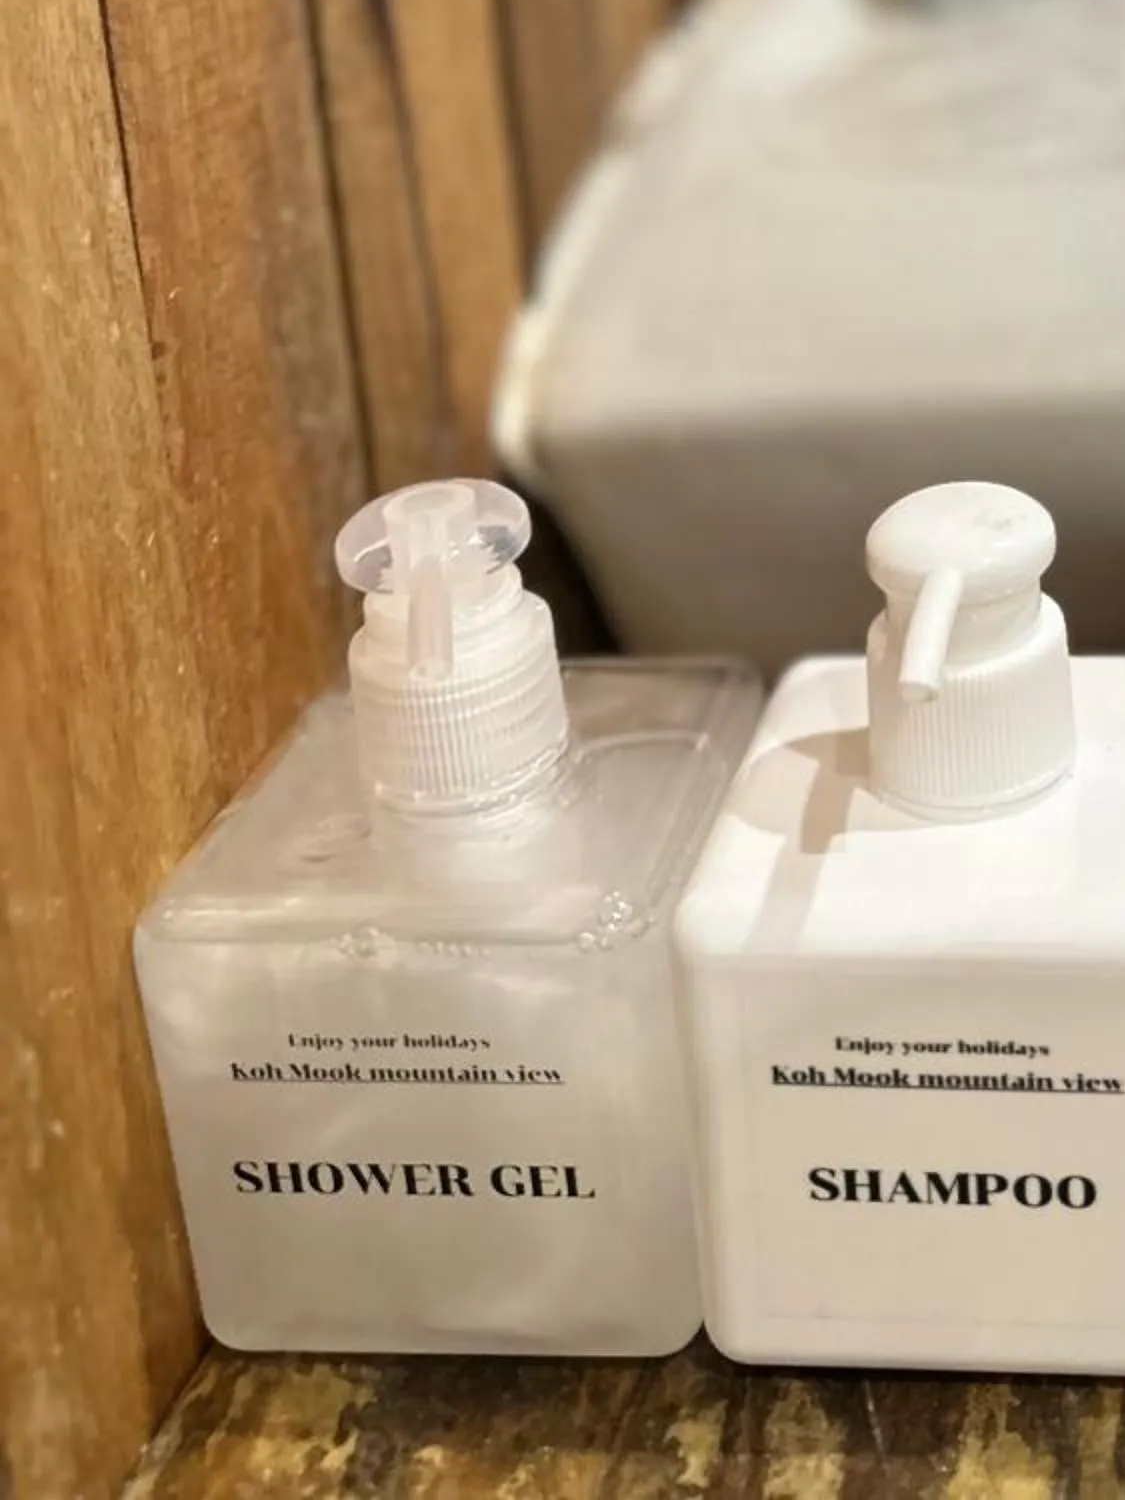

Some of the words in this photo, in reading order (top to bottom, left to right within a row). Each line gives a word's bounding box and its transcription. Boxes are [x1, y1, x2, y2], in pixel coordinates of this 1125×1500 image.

[288, 1032, 345, 1051] Enjoy
[351, 1036, 397, 1051] your
[402, 1033, 492, 1051] holidays
[834, 1036, 895, 1056] Enjoy
[901, 1041, 952, 1056] your
[957, 1038, 1051, 1057] holidays
[231, 1062, 284, 1081] Koh
[288, 1064, 362, 1082] Mook
[369, 1064, 497, 1083] mountain
[504, 1065, 562, 1084] view
[771, 1065, 826, 1085] Koh
[832, 1067, 911, 1087] Mook
[918, 1070, 1053, 1091] mountain
[1061, 1073, 1123, 1093] view
[232, 1161, 475, 1197] SHOWER
[489, 1165, 596, 1199] GEL
[807, 1167, 1099, 1210] SHAMPOO
